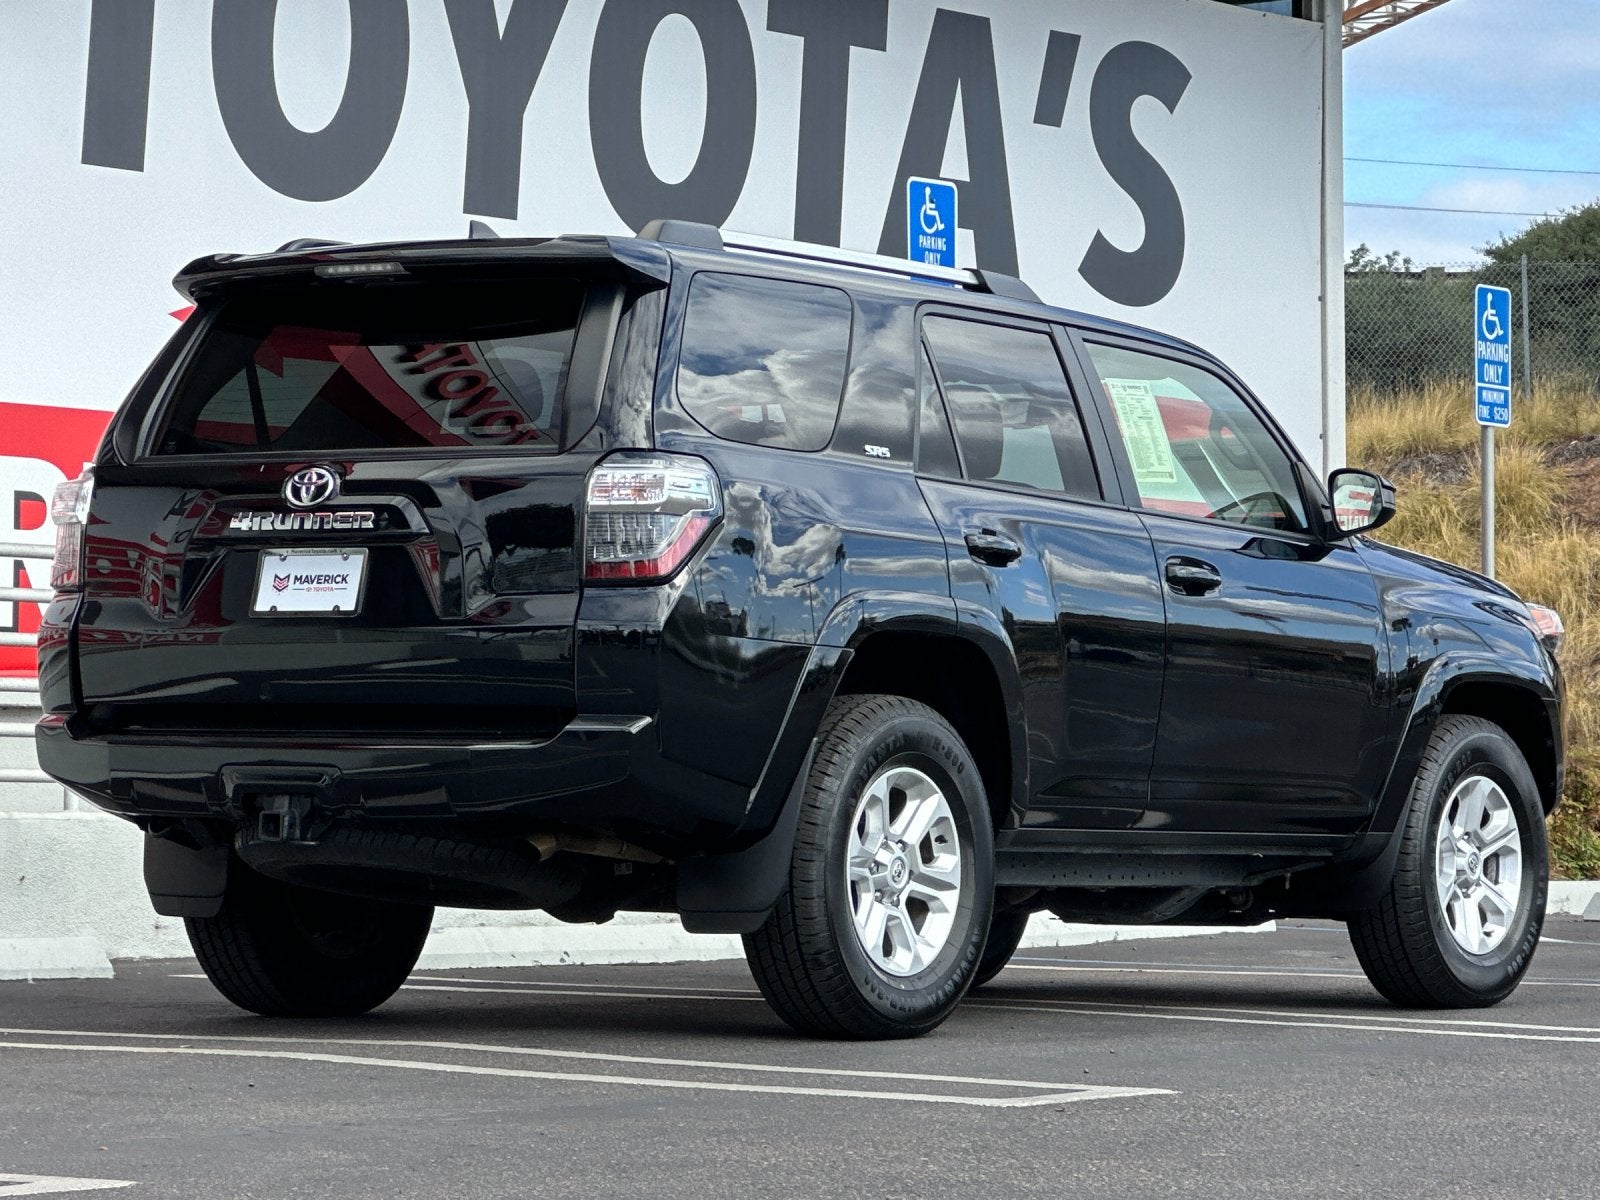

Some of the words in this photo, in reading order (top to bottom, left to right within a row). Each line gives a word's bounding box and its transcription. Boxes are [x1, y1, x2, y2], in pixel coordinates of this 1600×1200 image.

[919, 235, 946, 251] PARKING
[924, 251, 941, 266] ONLY
[1478, 341, 1509, 363] PARKING
[1484, 363, 1503, 383] ONLY
[1482, 390, 1504, 404] MINIMUM
[1479, 405, 1490, 418] FINE
[1494, 407, 1508, 421] $250
[864, 444, 891, 458] SR5
[230, 511, 375, 531] 4RUNNER
[293, 573, 349, 585] MAVERICK
